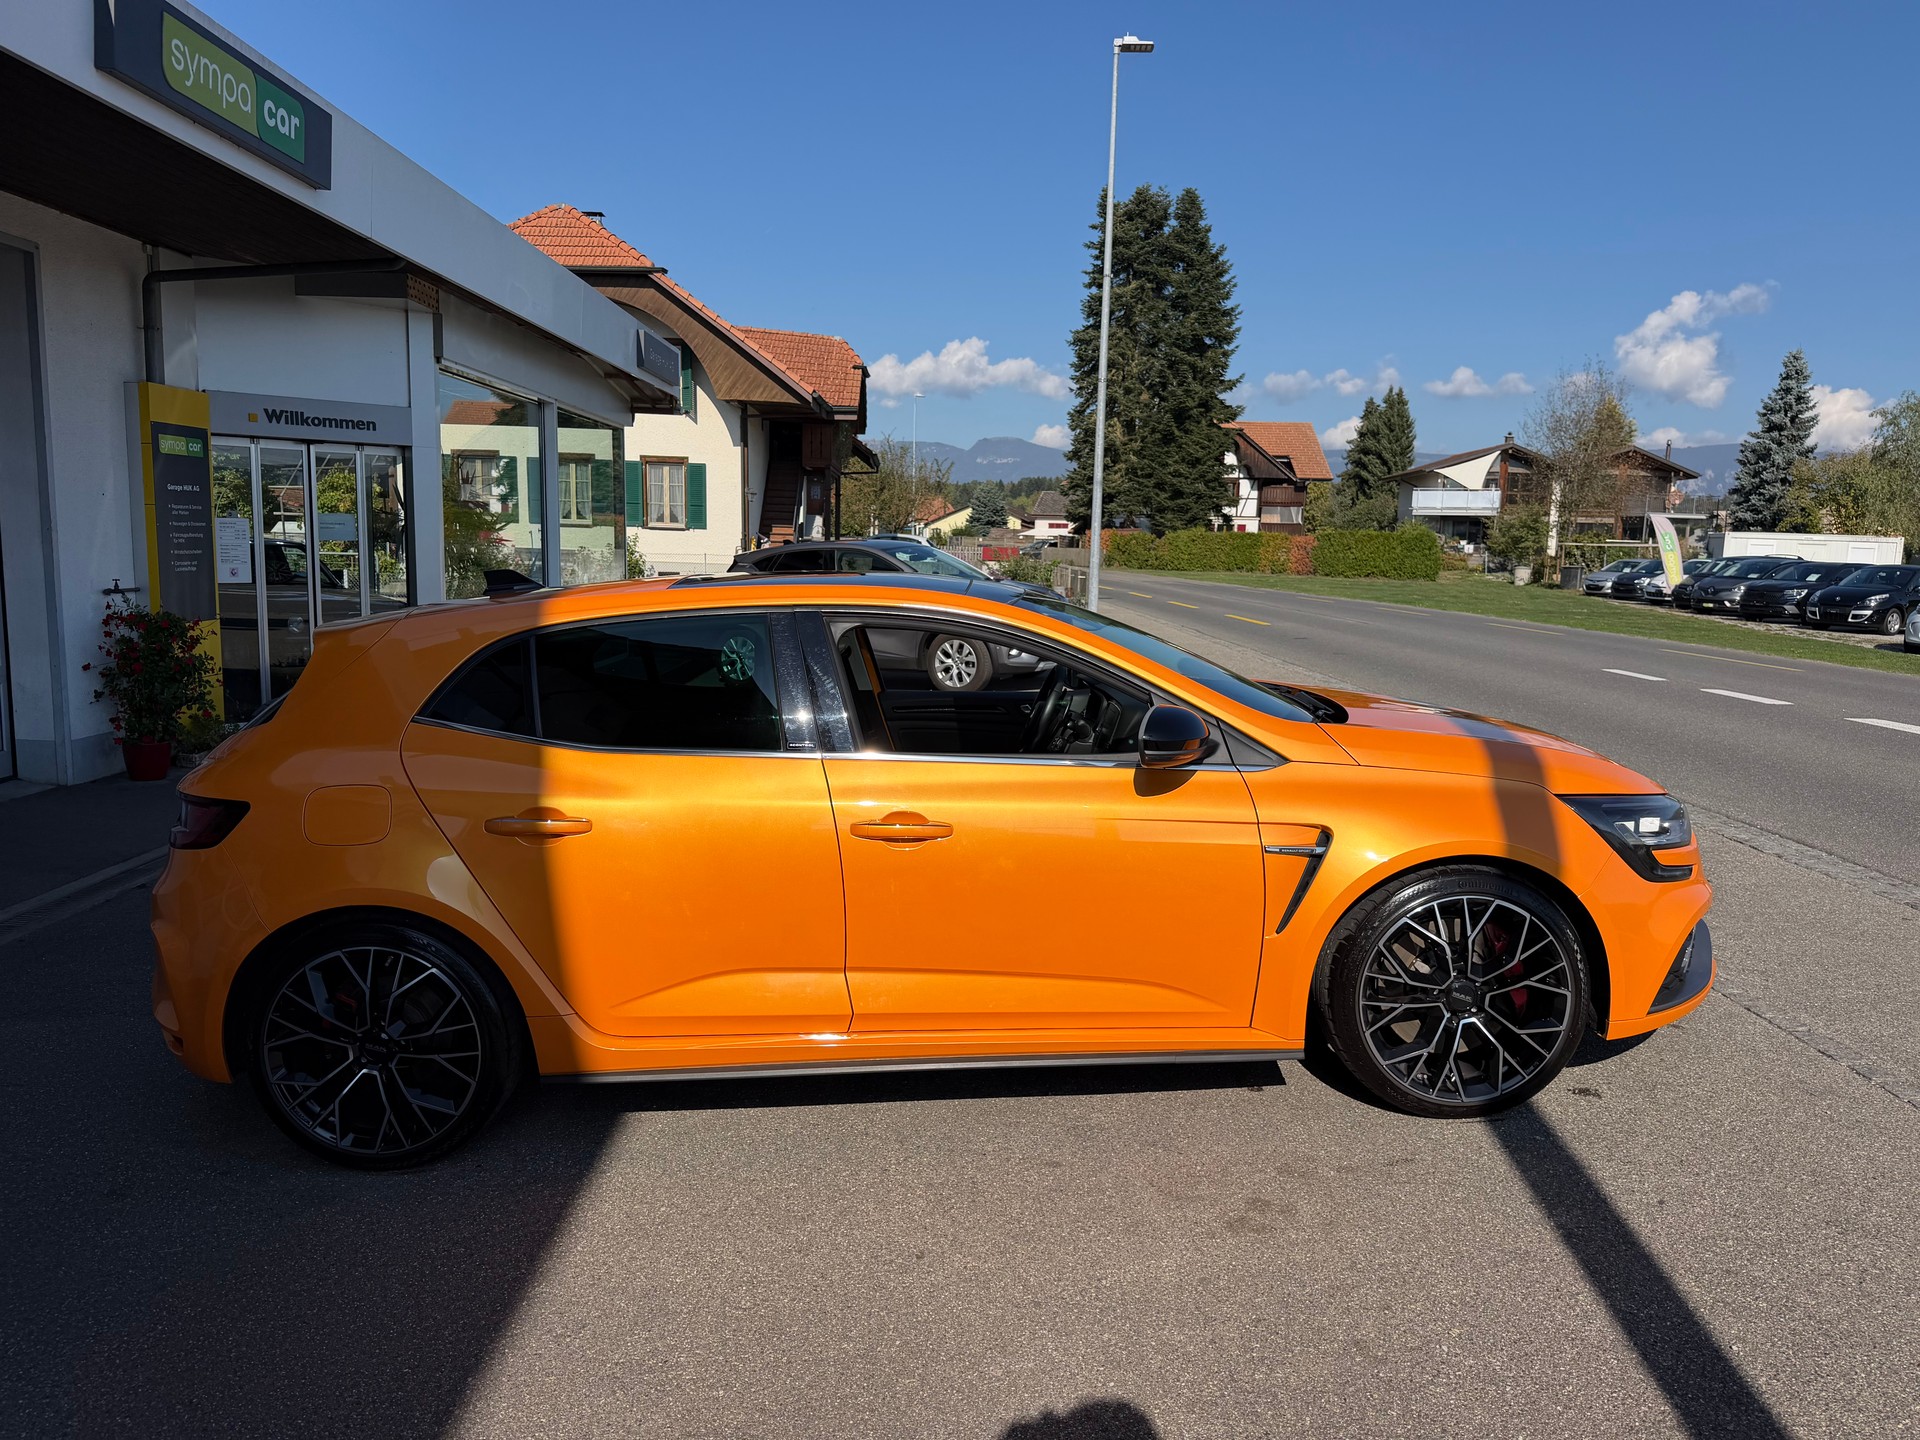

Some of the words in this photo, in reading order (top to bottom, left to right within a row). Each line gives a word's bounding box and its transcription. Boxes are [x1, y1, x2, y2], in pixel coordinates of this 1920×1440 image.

[171, 38, 252, 115] sympa
[263, 99, 300, 140] car
[263, 408, 377, 432] Willkommen
[161, 440, 186, 453] sympa
[188, 443, 202, 452] car
[167, 484, 183, 492] Garage
[1452, 991, 1473, 1001] MAK
